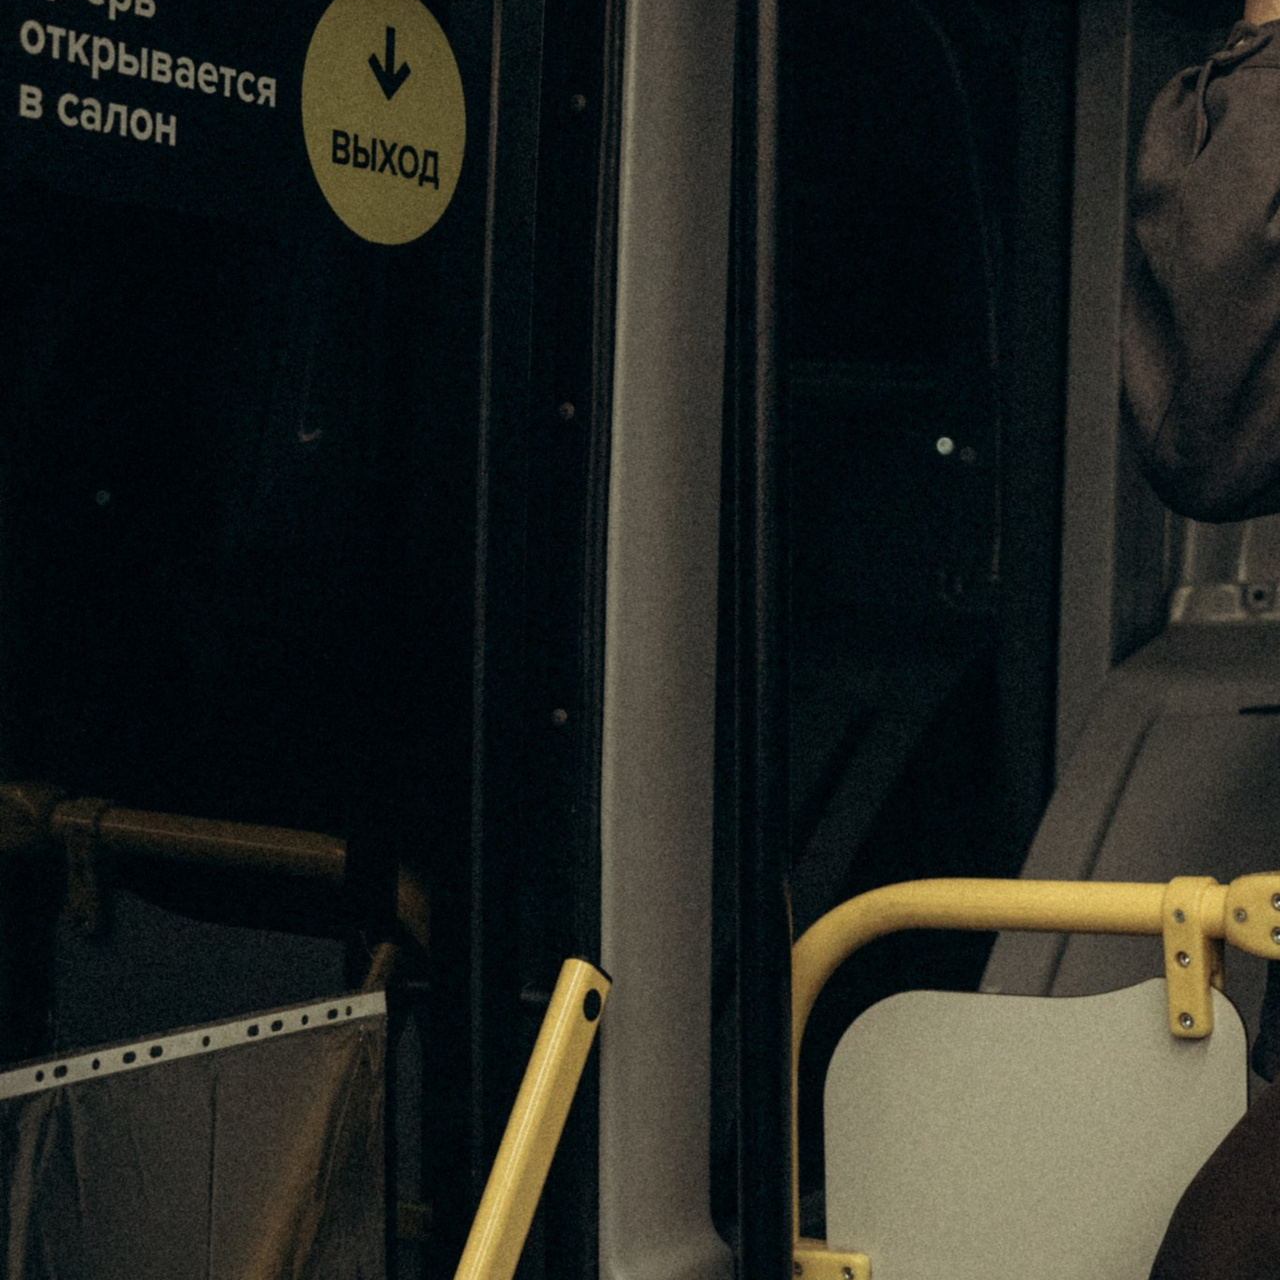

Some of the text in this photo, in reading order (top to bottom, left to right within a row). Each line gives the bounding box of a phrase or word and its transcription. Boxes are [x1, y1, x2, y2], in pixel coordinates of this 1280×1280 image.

[20, 19, 277, 108] открывается
[19, 84, 177, 146] в салон
[331, 128, 440, 191] ВЫХОД
